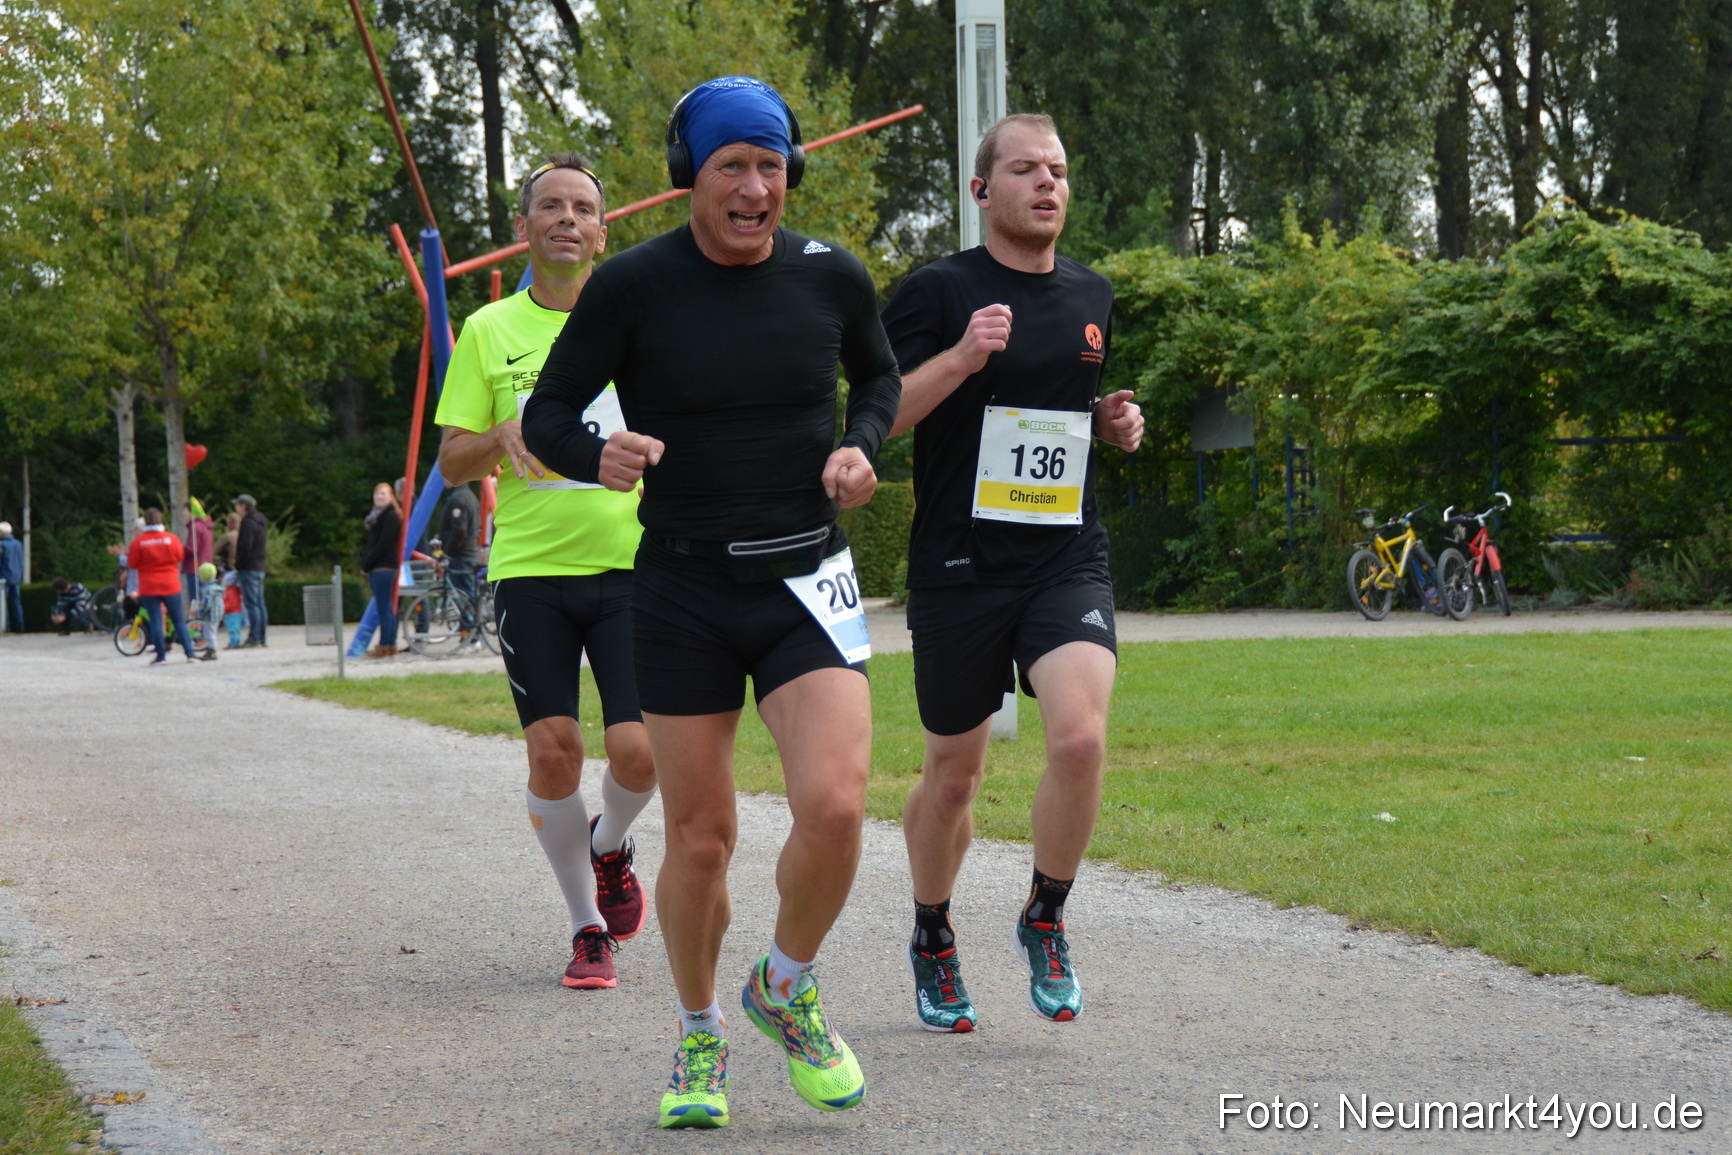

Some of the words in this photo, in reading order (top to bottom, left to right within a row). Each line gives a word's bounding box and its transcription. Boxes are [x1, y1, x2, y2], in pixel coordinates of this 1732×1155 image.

[1029, 421, 1066, 432] BOCK
[1010, 444, 1067, 480] 136
[1009, 489, 1057, 504] Christian
[945, 557, 971, 568] SPIRO
[816, 567, 860, 615] 20
[1081, 617, 1108, 631] adidas
